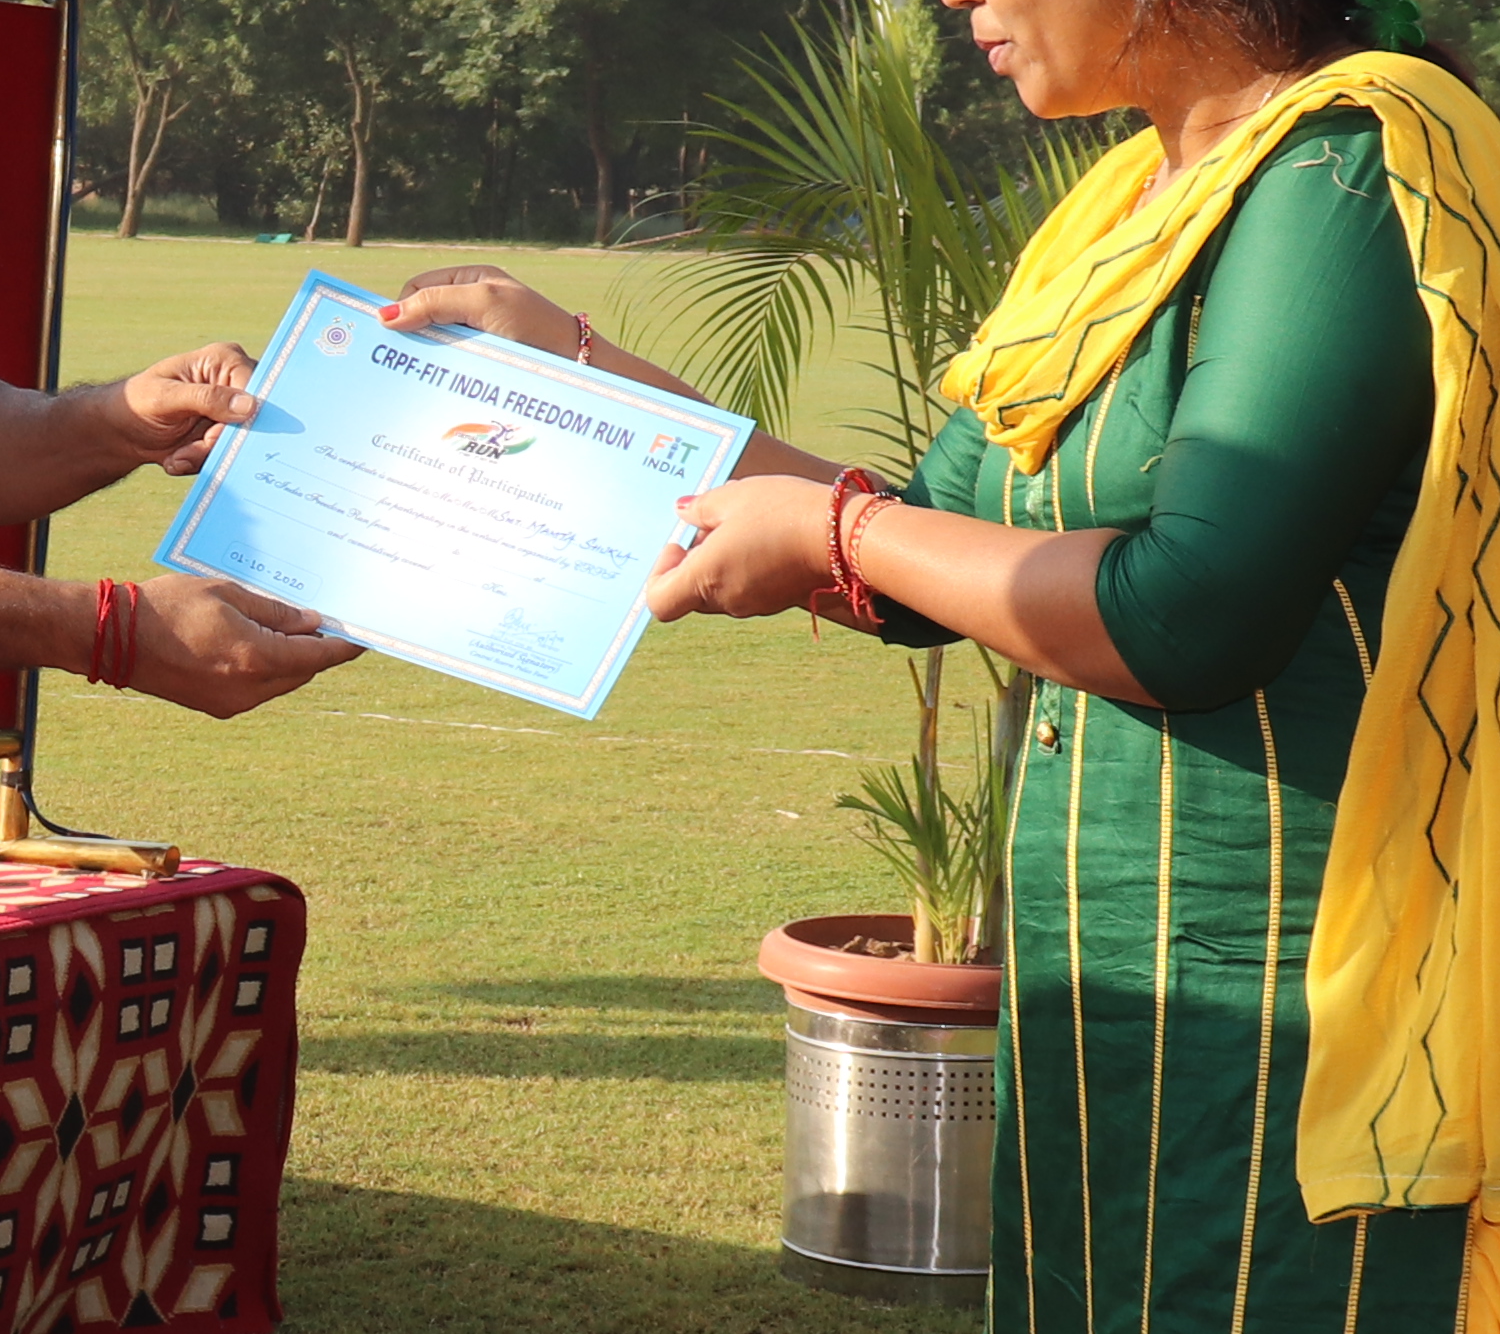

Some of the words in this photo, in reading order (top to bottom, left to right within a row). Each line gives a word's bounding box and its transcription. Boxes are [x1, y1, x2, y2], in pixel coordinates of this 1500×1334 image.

[371, 343, 449, 386] CRPF-FIT
[448, 372, 499, 406] INDIA
[502, 390, 592, 436] FREEDOM
[592, 420, 635, 450] RUN
[313, 445, 337, 460] This
[461, 441, 506, 459] RUN
[371, 434, 444, 469] Certificate
[448, 465, 465, 476] of
[467, 468, 563, 510] Participation
[641, 455, 684, 478] INDIA
